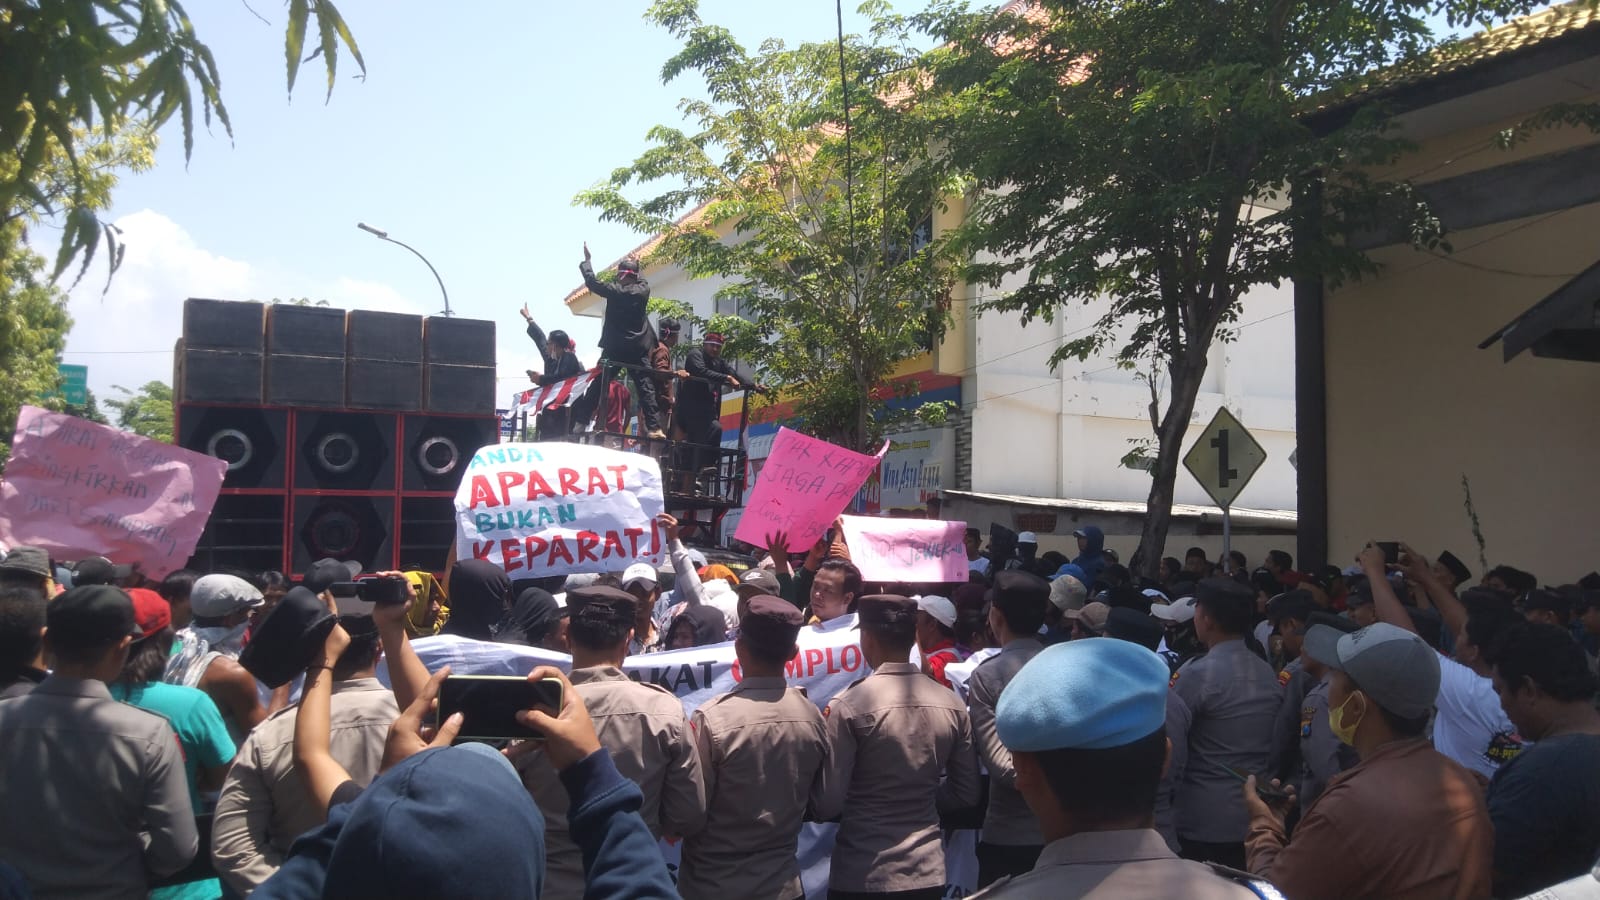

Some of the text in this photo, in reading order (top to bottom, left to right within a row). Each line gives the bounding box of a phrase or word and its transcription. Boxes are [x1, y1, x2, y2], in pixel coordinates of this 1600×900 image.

[470, 448, 544, 469] ANDA
[469, 464, 628, 510] APARAT
[767, 463, 826, 495] JAGA
[475, 503, 577, 533] BUKAN
